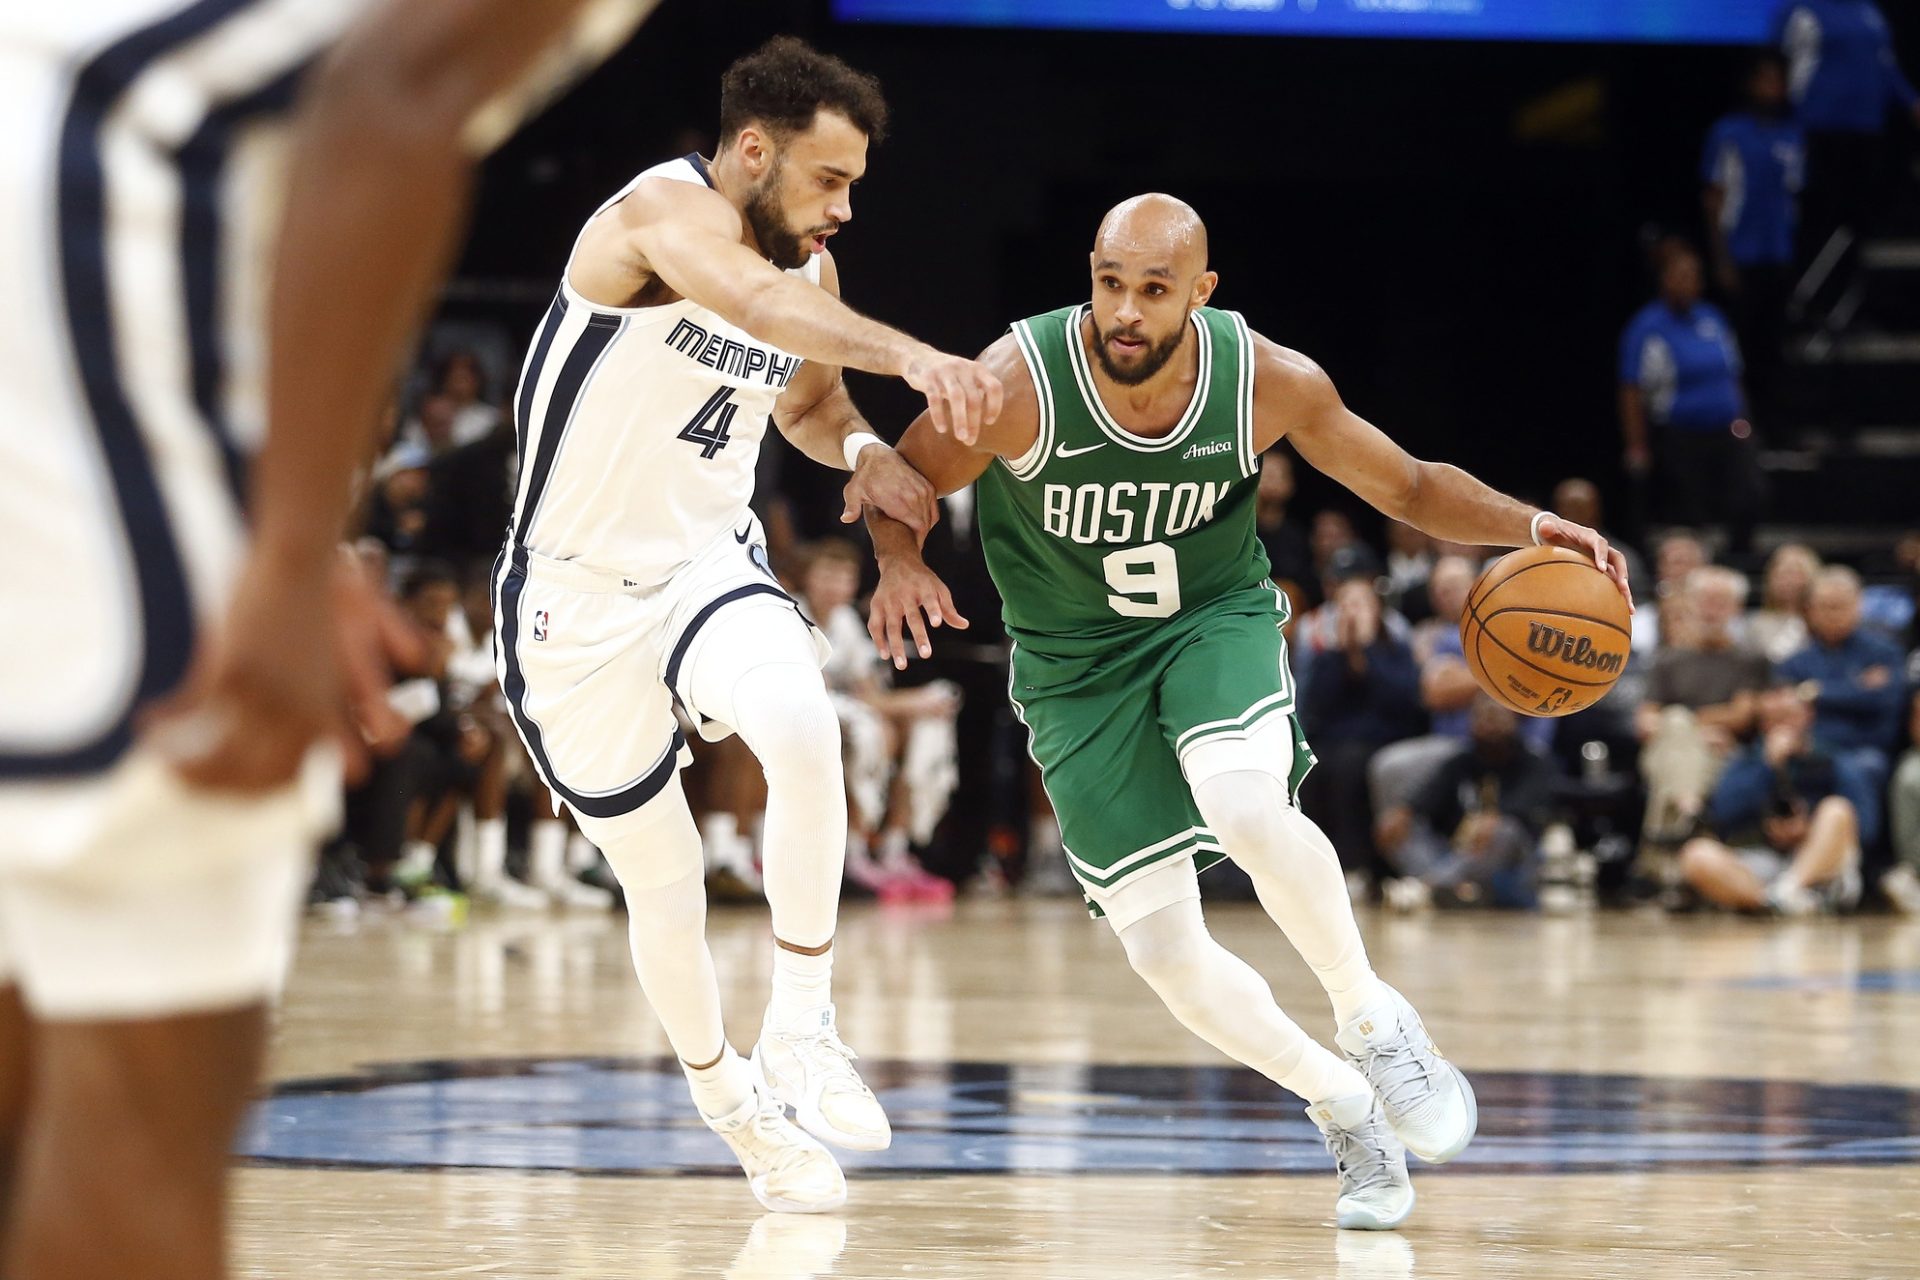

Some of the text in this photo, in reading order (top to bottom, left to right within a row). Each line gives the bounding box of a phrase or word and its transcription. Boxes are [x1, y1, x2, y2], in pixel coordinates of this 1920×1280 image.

[665, 317, 803, 387] MEMPHI
[676, 385, 739, 459] 4
[1182, 441, 1232, 460] Amica
[1043, 480, 1231, 544] BOSTON
[1102, 541, 1181, 618] 9
[1528, 620, 1623, 673] Wilson
